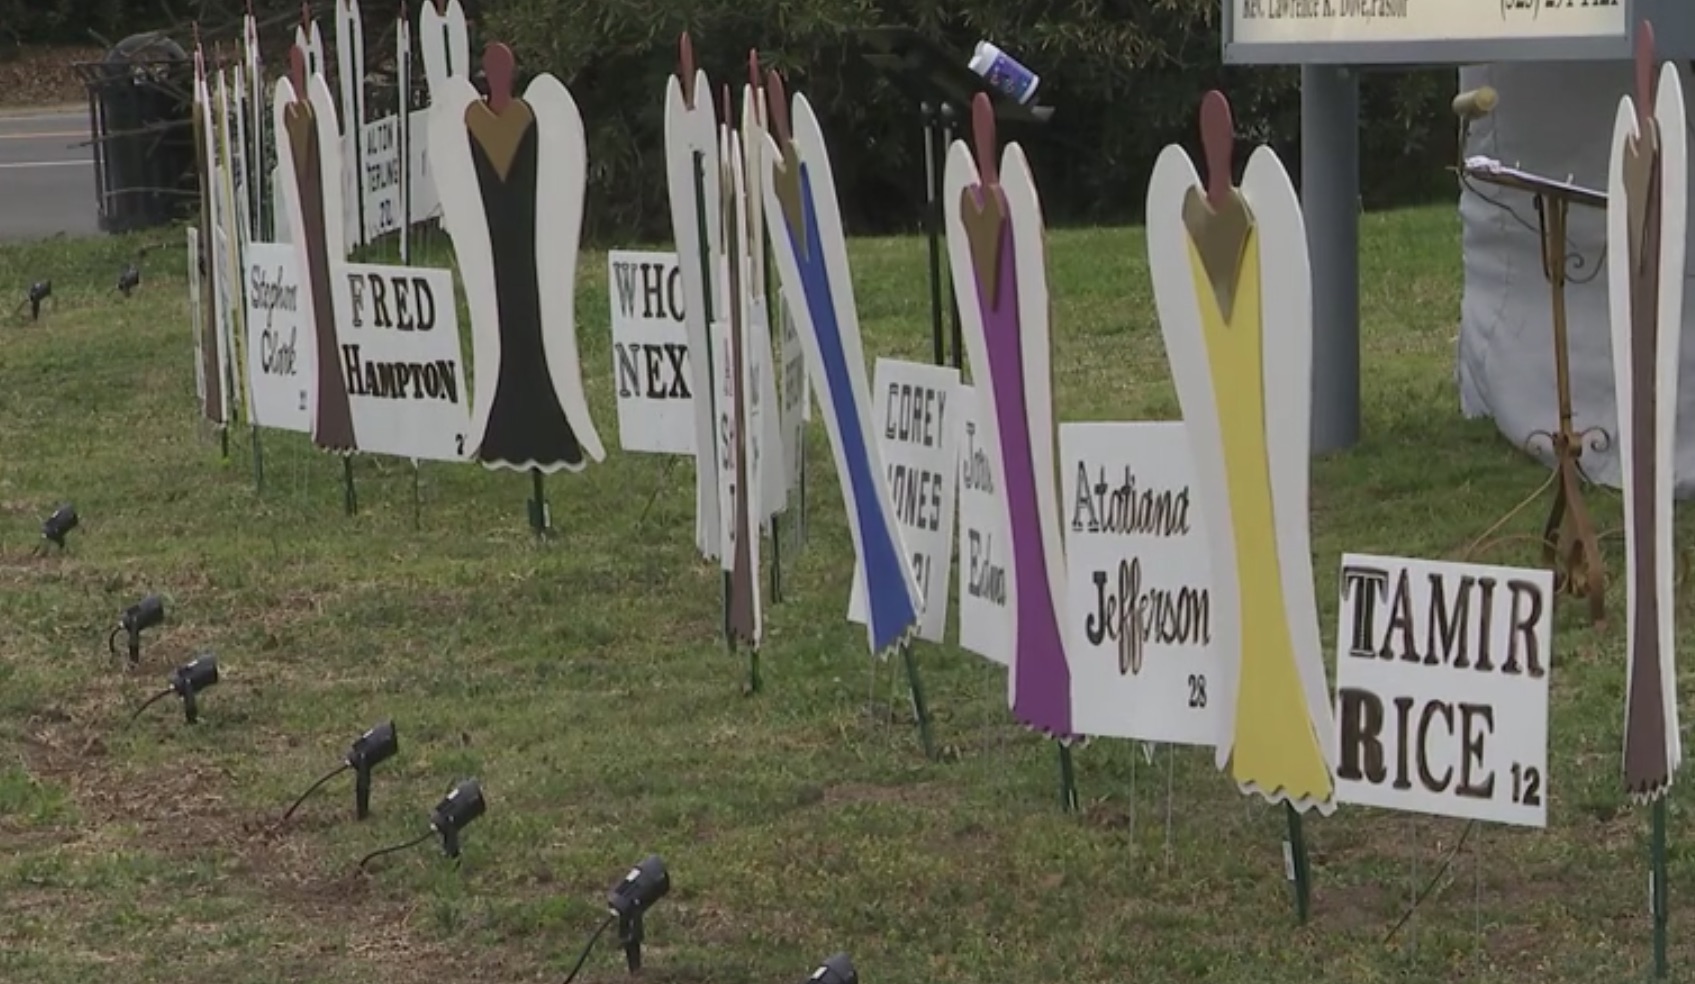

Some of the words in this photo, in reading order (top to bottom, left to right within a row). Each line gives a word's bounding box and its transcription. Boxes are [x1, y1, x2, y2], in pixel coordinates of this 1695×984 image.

[347, 273, 436, 332] FRED
[342, 344, 459, 404] HAMPTON
[614, 343, 693, 400] NEX
[884, 382, 947, 449] COREY
[887, 463, 943, 532] ONES
[1085, 556, 1211, 676] Jefferson
[1342, 566, 1546, 678] TAMIR
[1187, 674, 1208, 708] 28
[1337, 687, 1496, 800] RICE
[1509, 761, 1541, 807] 12
